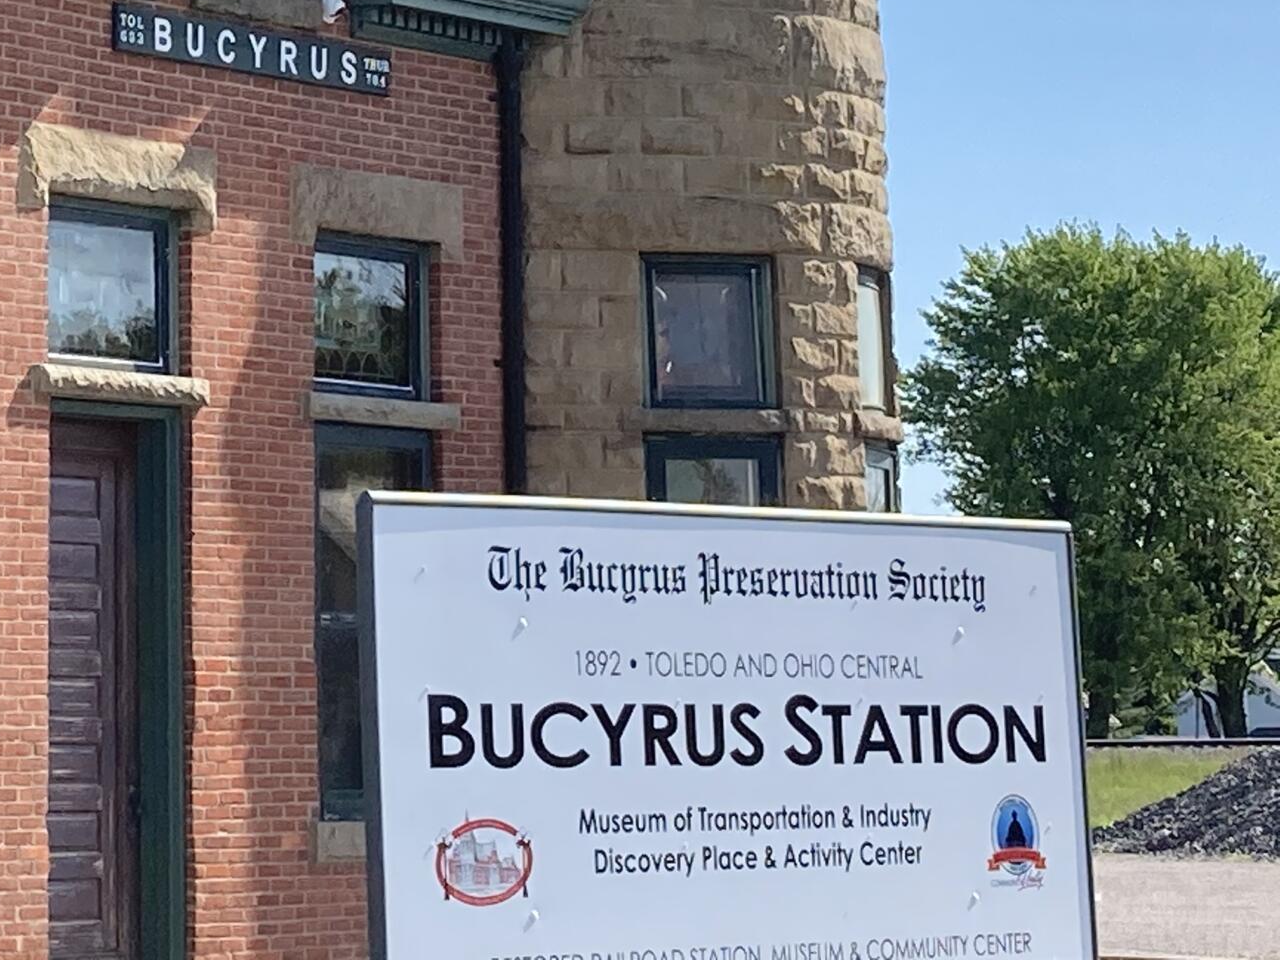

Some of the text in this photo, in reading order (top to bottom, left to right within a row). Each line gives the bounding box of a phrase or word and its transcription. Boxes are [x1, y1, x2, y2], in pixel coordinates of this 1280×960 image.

[120, 12, 144, 30] TOL
[154, 17, 357, 85] BUCYRUS
[488, 546, 986, 613] The Bucyrus Preservation Society
[576, 650, 924, 680] 1892 TOLEDO AND OHIO CENTRAL
[427, 693, 1047, 769] BUCYRUS STATION
[579, 803, 932, 837] Museum of Transportation & Industry
[594, 840, 923, 878] Discovery Place & Activity Center
[850, 941, 861, 960] &
[866, 935, 968, 960] COMMUNITY
[973, 932, 1032, 956] CENTER
